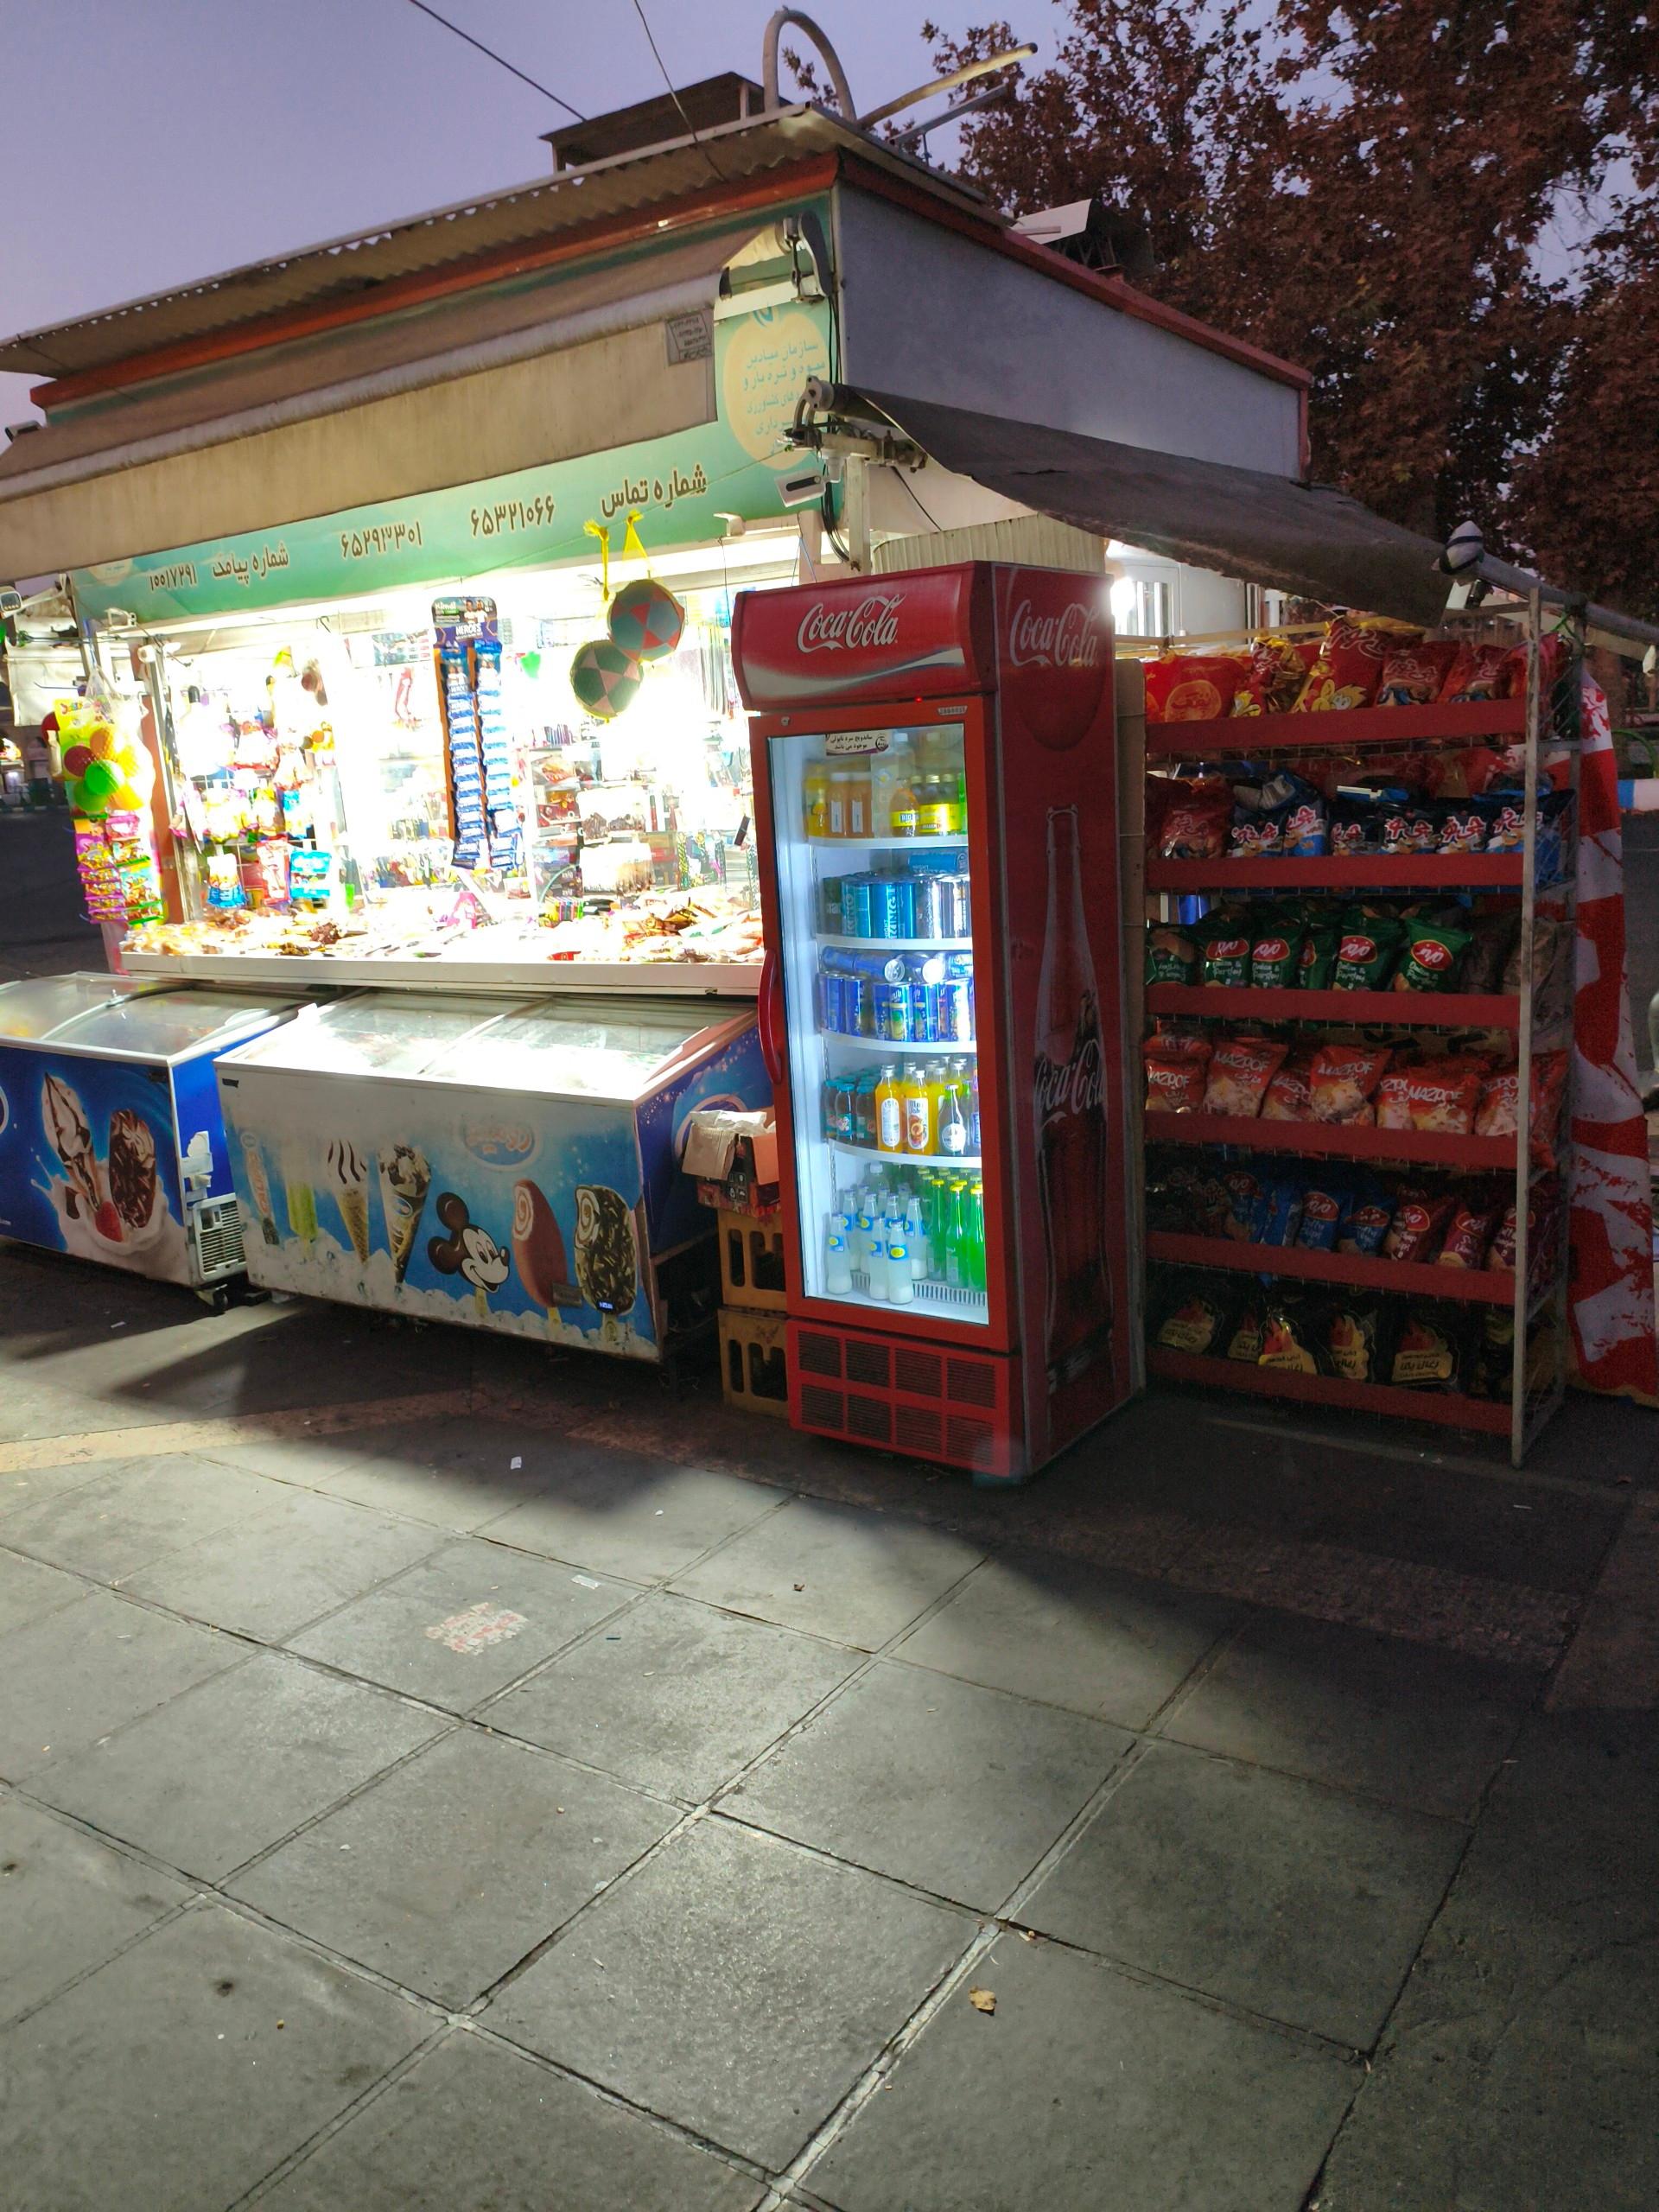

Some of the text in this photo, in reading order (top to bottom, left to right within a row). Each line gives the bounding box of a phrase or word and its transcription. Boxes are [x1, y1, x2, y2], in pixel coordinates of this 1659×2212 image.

[471, 495, 555, 536] ۶۵۳۲۱۰۶۶
[601, 464, 707, 518] شماره تماس
[252, 543, 289, 576] شماره
[798, 593, 906, 654] Coca-Cola
[1009, 599, 1103, 667] Coca-Cola
